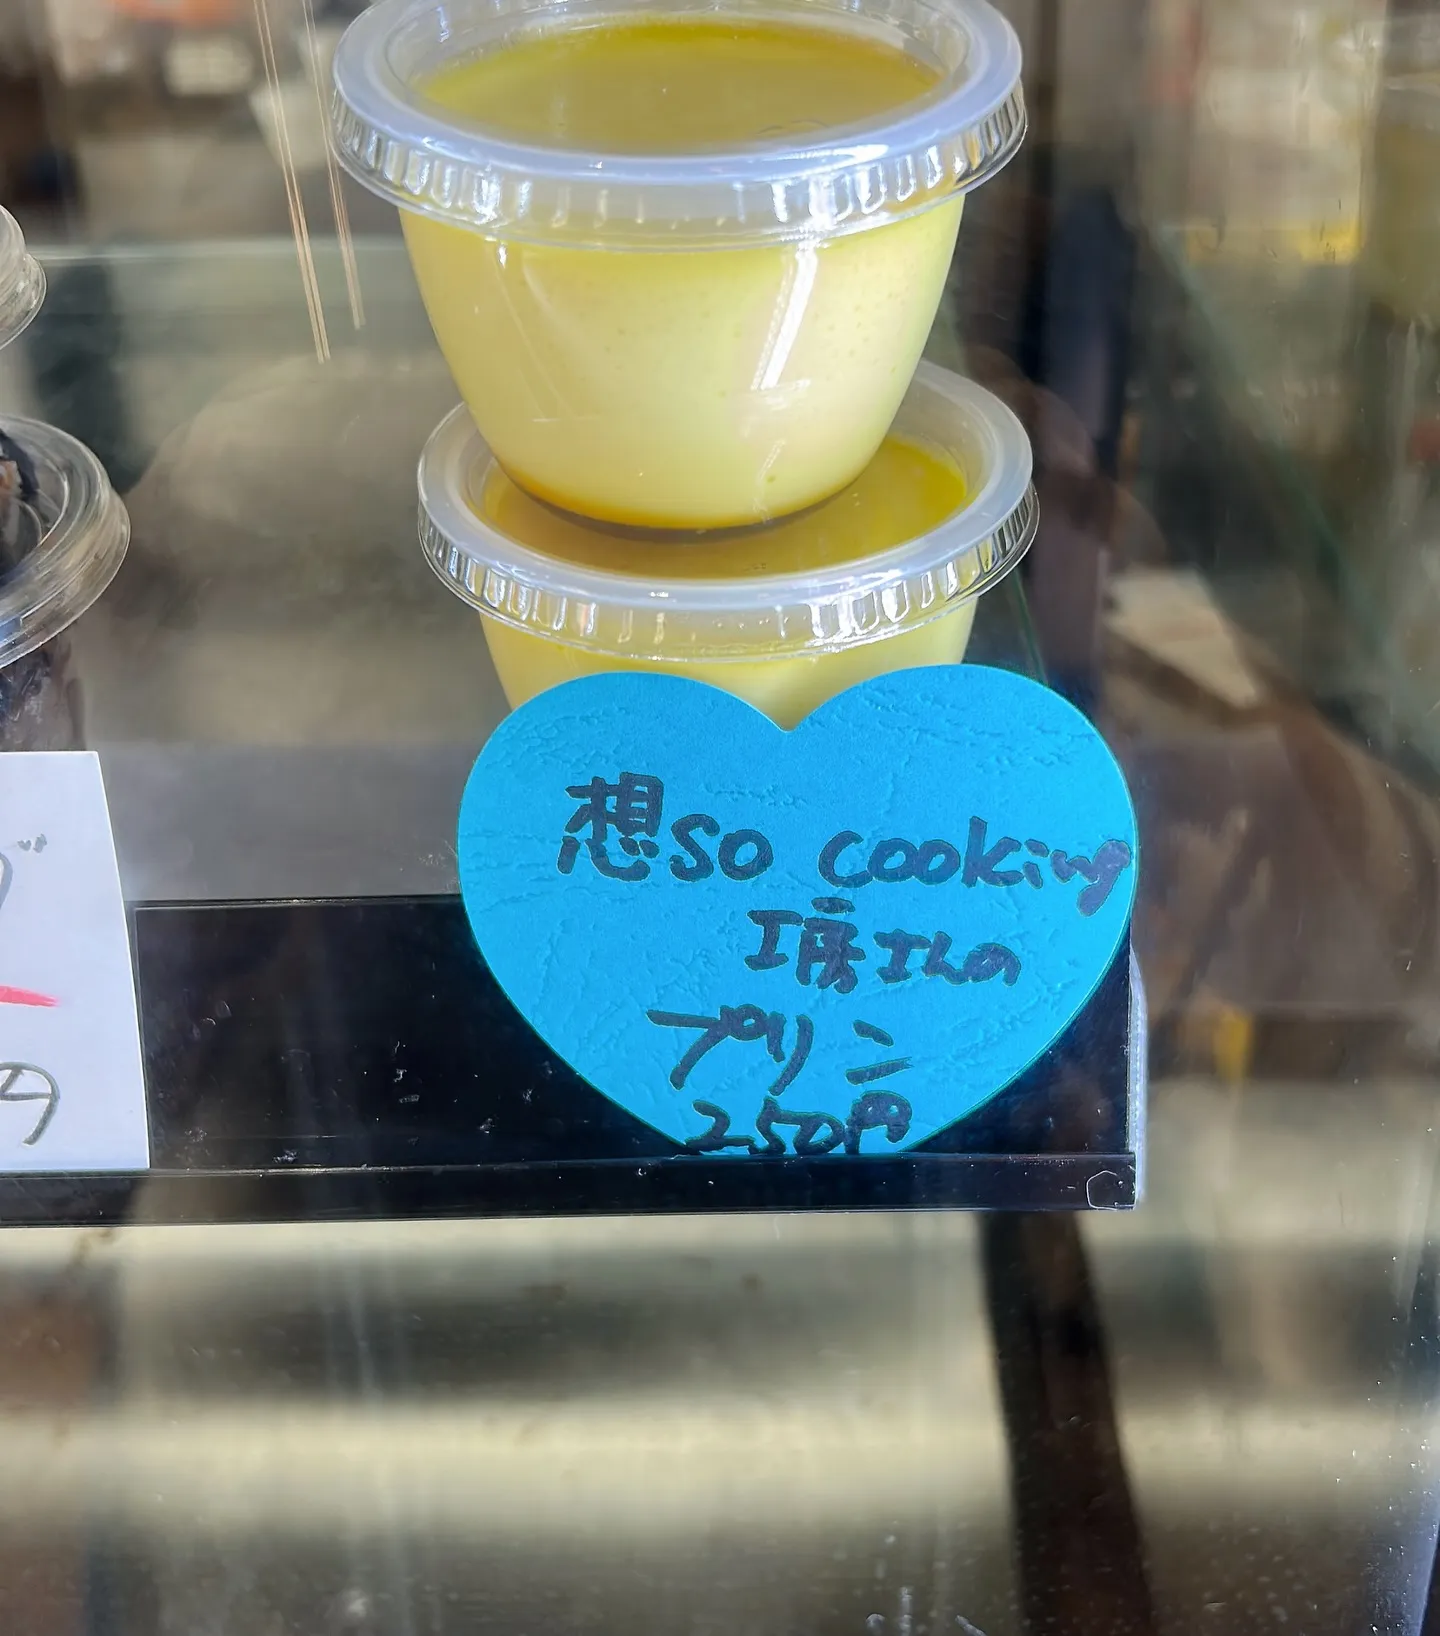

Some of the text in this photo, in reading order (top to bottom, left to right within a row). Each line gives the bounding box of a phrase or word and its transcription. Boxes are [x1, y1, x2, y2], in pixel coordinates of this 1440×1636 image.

[646, 1003, 914, 1097] プリン
[686, 1090, 912, 1154] 250円
